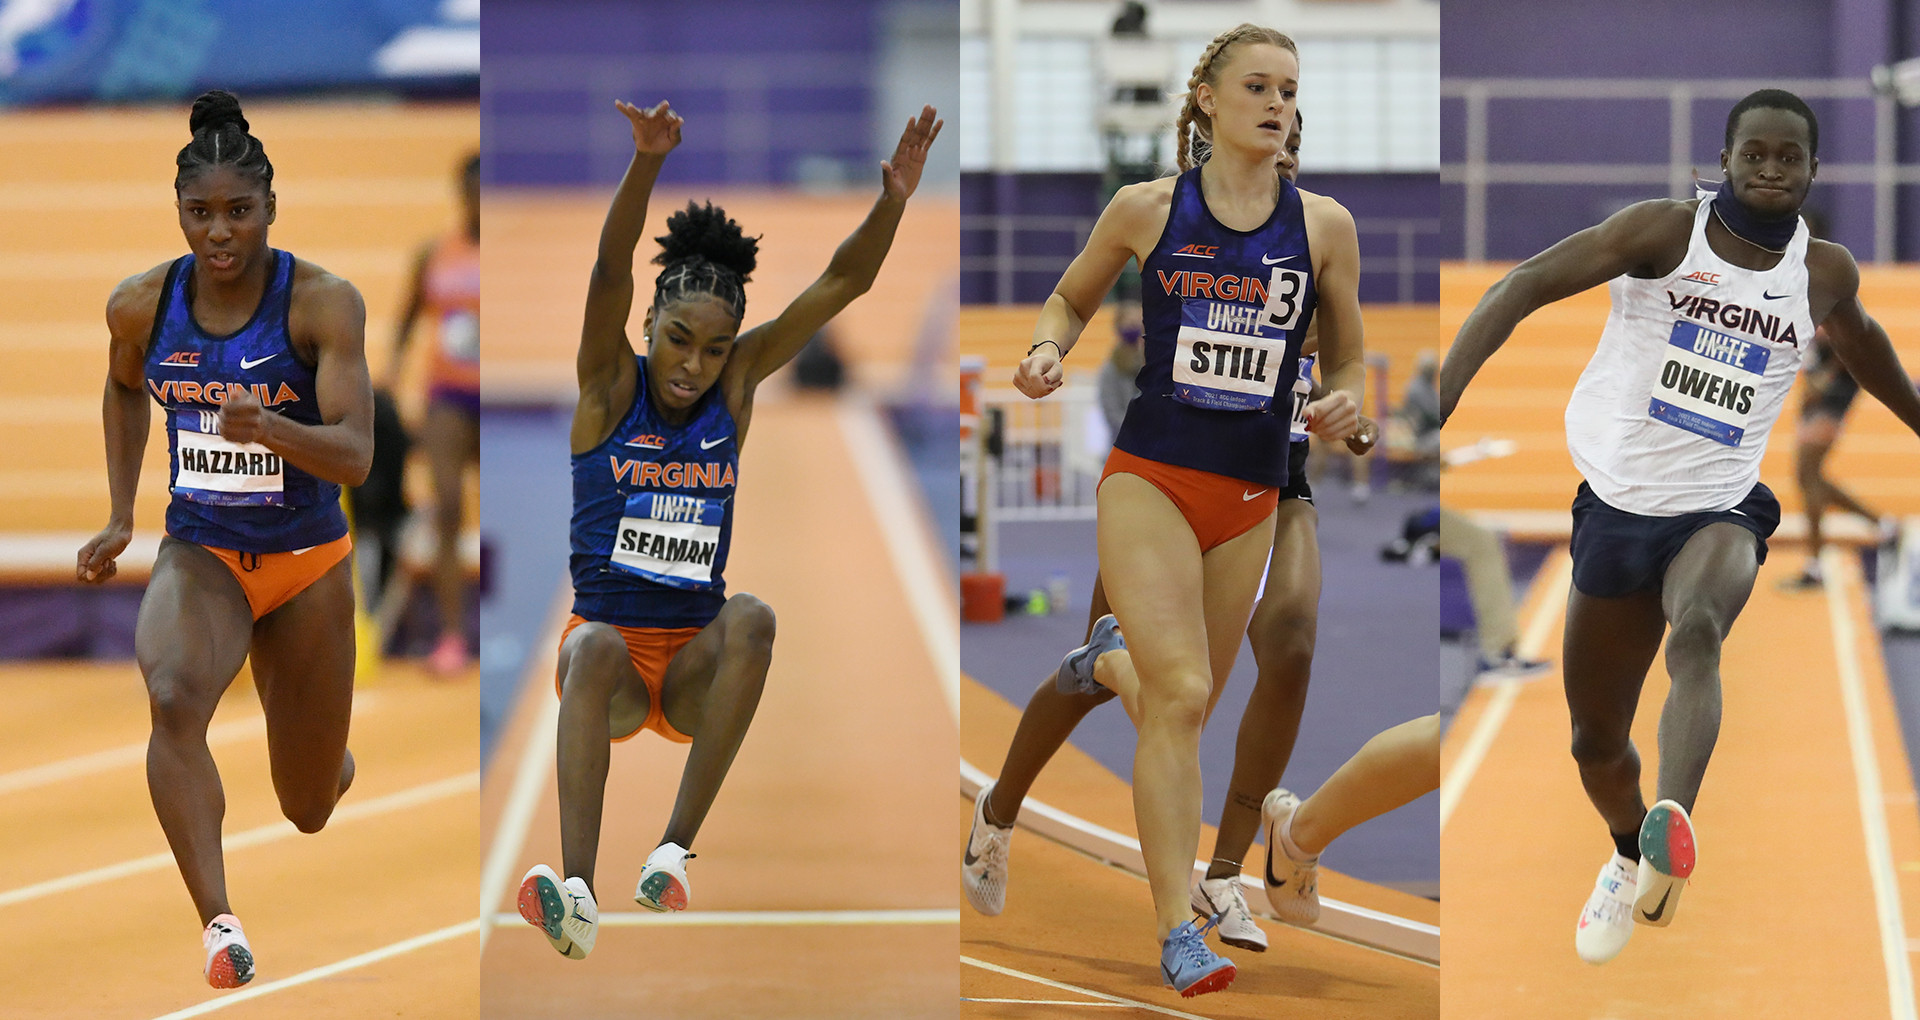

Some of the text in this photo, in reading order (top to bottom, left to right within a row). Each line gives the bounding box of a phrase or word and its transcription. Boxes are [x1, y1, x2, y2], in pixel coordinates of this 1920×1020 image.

[1176, 244, 1220, 256] ACC
[1157, 269, 1272, 305] VIRGIN
[1686, 271, 1722, 283] ACC
[1269, 272, 1301, 326] 3
[1667, 290, 1798, 349] VIRGINIA
[164, 351, 202, 364] ACC
[1190, 341, 1269, 383] STILL
[1693, 328, 1751, 368] UNITE
[1660, 360, 1755, 415] OWENS
[630, 434, 667, 446] ACC
[181, 447, 280, 476] HAZZARD
[609, 455, 736, 488] VIRGINIA
[650, 494, 706, 524] UNITE
[620, 528, 716, 567] SEAMAN
